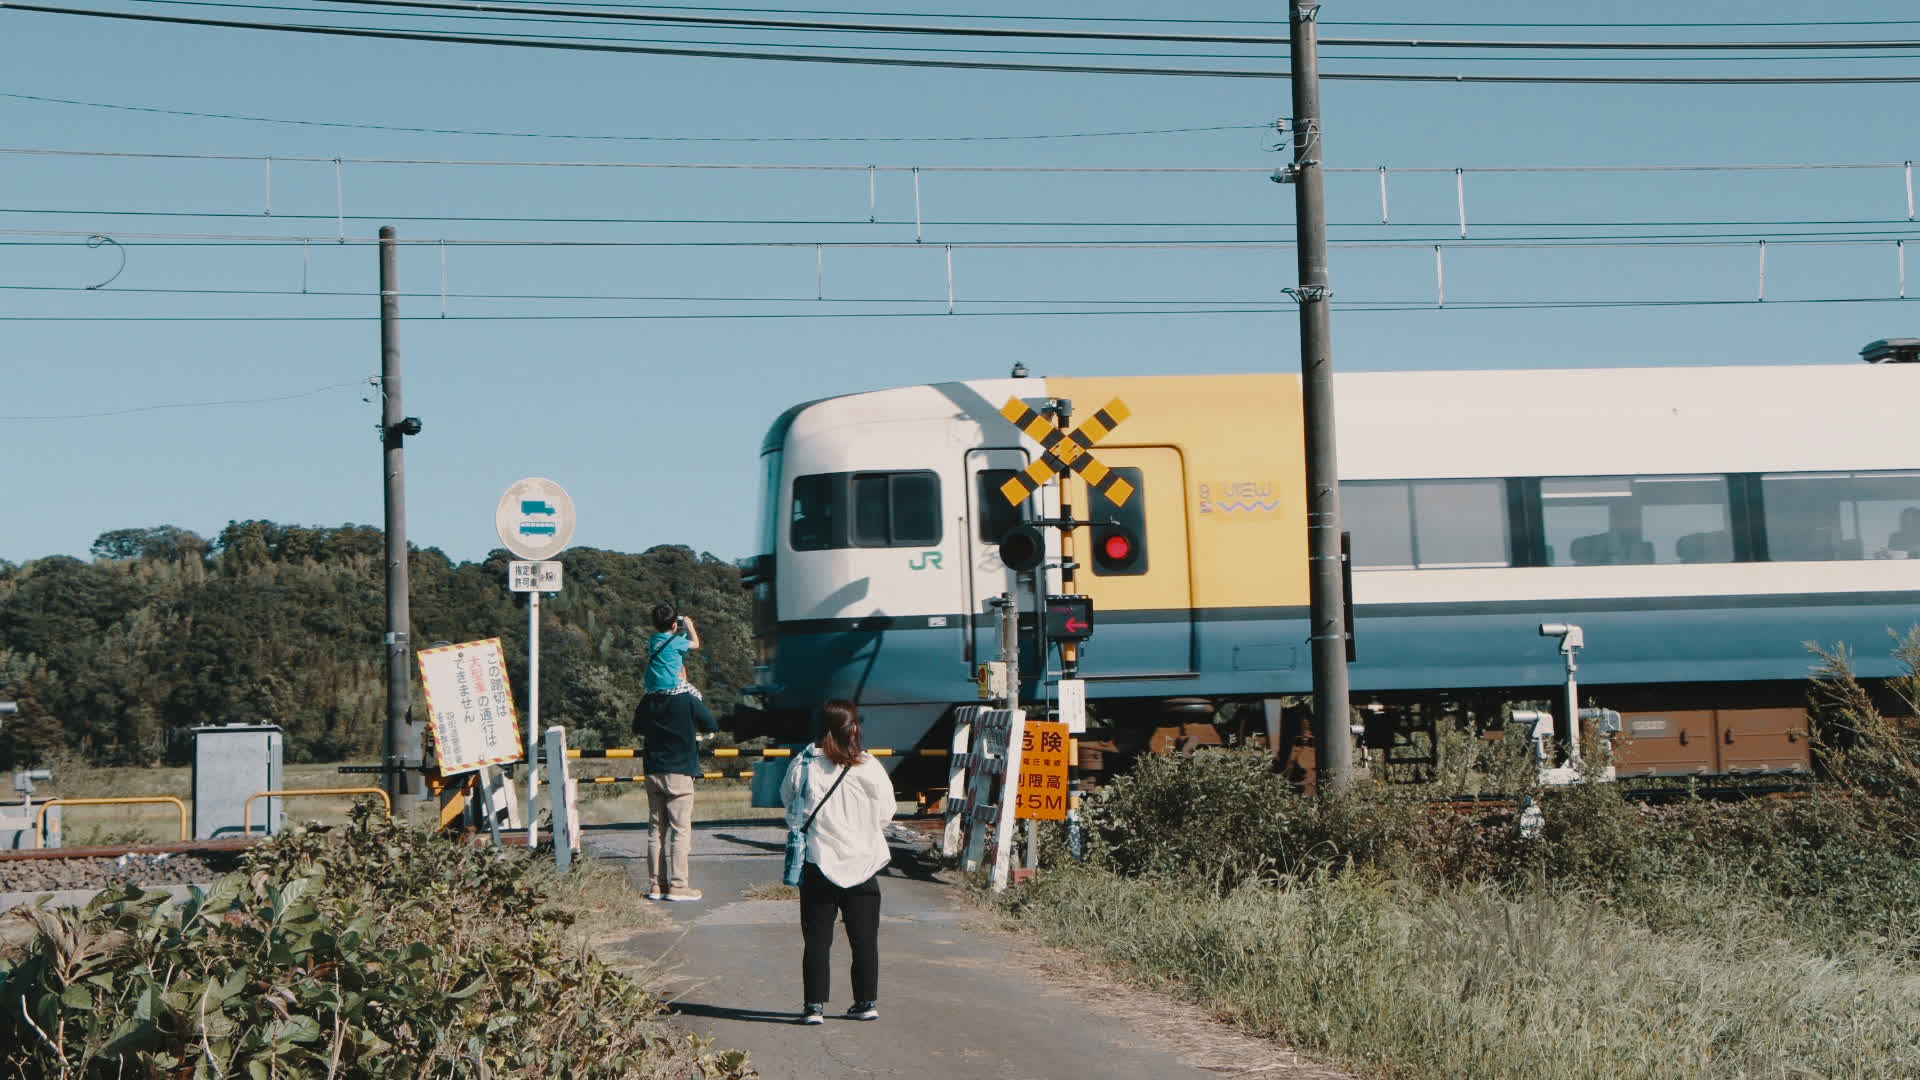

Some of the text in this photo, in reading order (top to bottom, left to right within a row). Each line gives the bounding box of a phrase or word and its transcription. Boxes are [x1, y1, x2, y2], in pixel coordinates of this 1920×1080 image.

[908, 551, 944, 571] JR
[452, 658, 475, 724] できません
[487, 652, 508, 717] この踏切は
